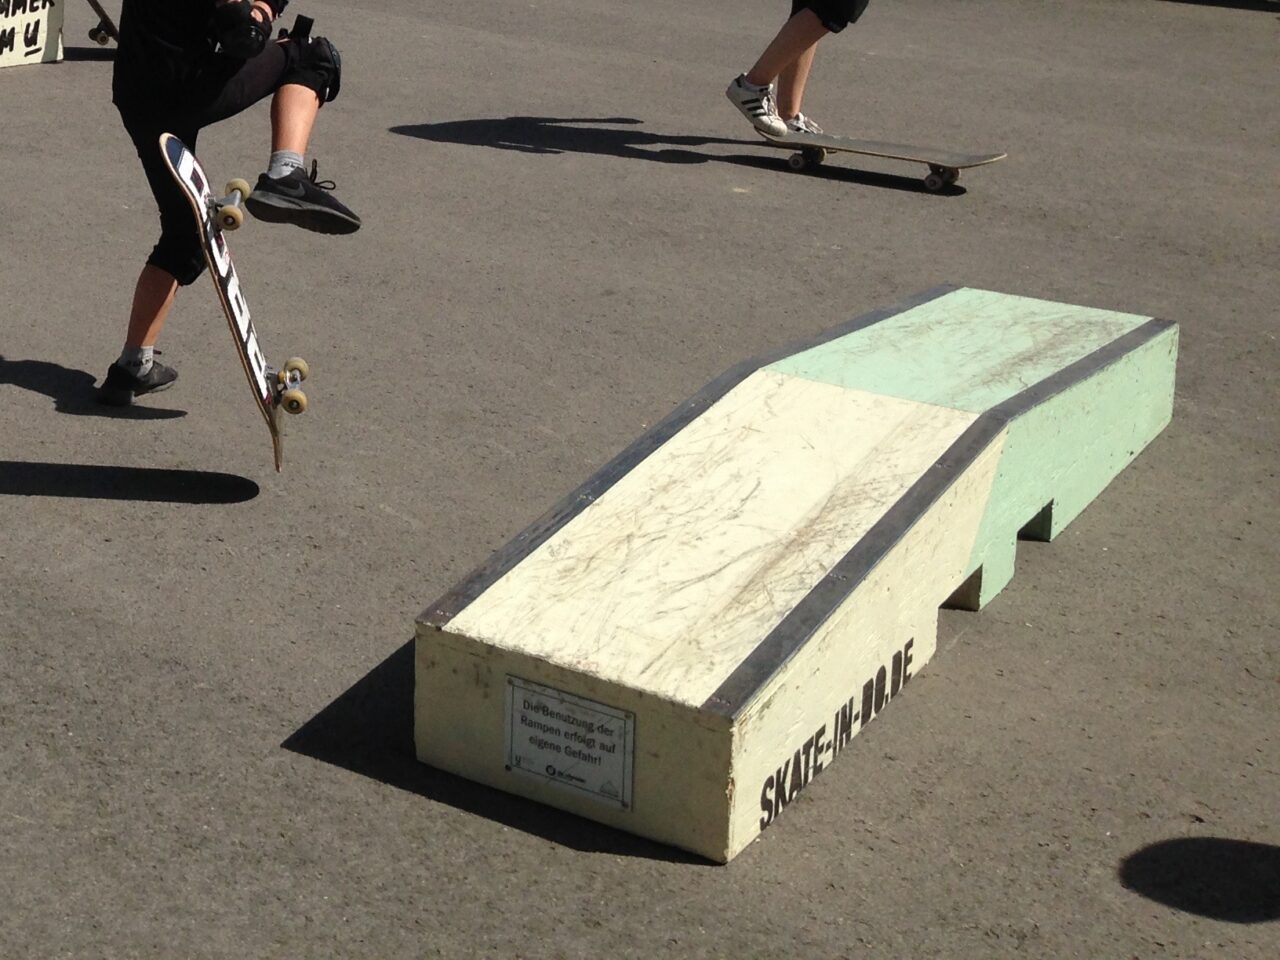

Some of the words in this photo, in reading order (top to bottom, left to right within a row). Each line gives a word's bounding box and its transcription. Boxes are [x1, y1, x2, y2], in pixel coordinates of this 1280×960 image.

[521, 715, 560, 737] Rampen
[564, 731, 595, 749] erfolgt
[599, 742, 616, 754] auf
[523, 700, 540, 713] Die
[542, 705, 595, 733] Benutzung
[597, 724, 615, 737] der
[760, 637, 914, 831] SKATE-IN-DO.DE
[529, 735, 561, 753] eigene
